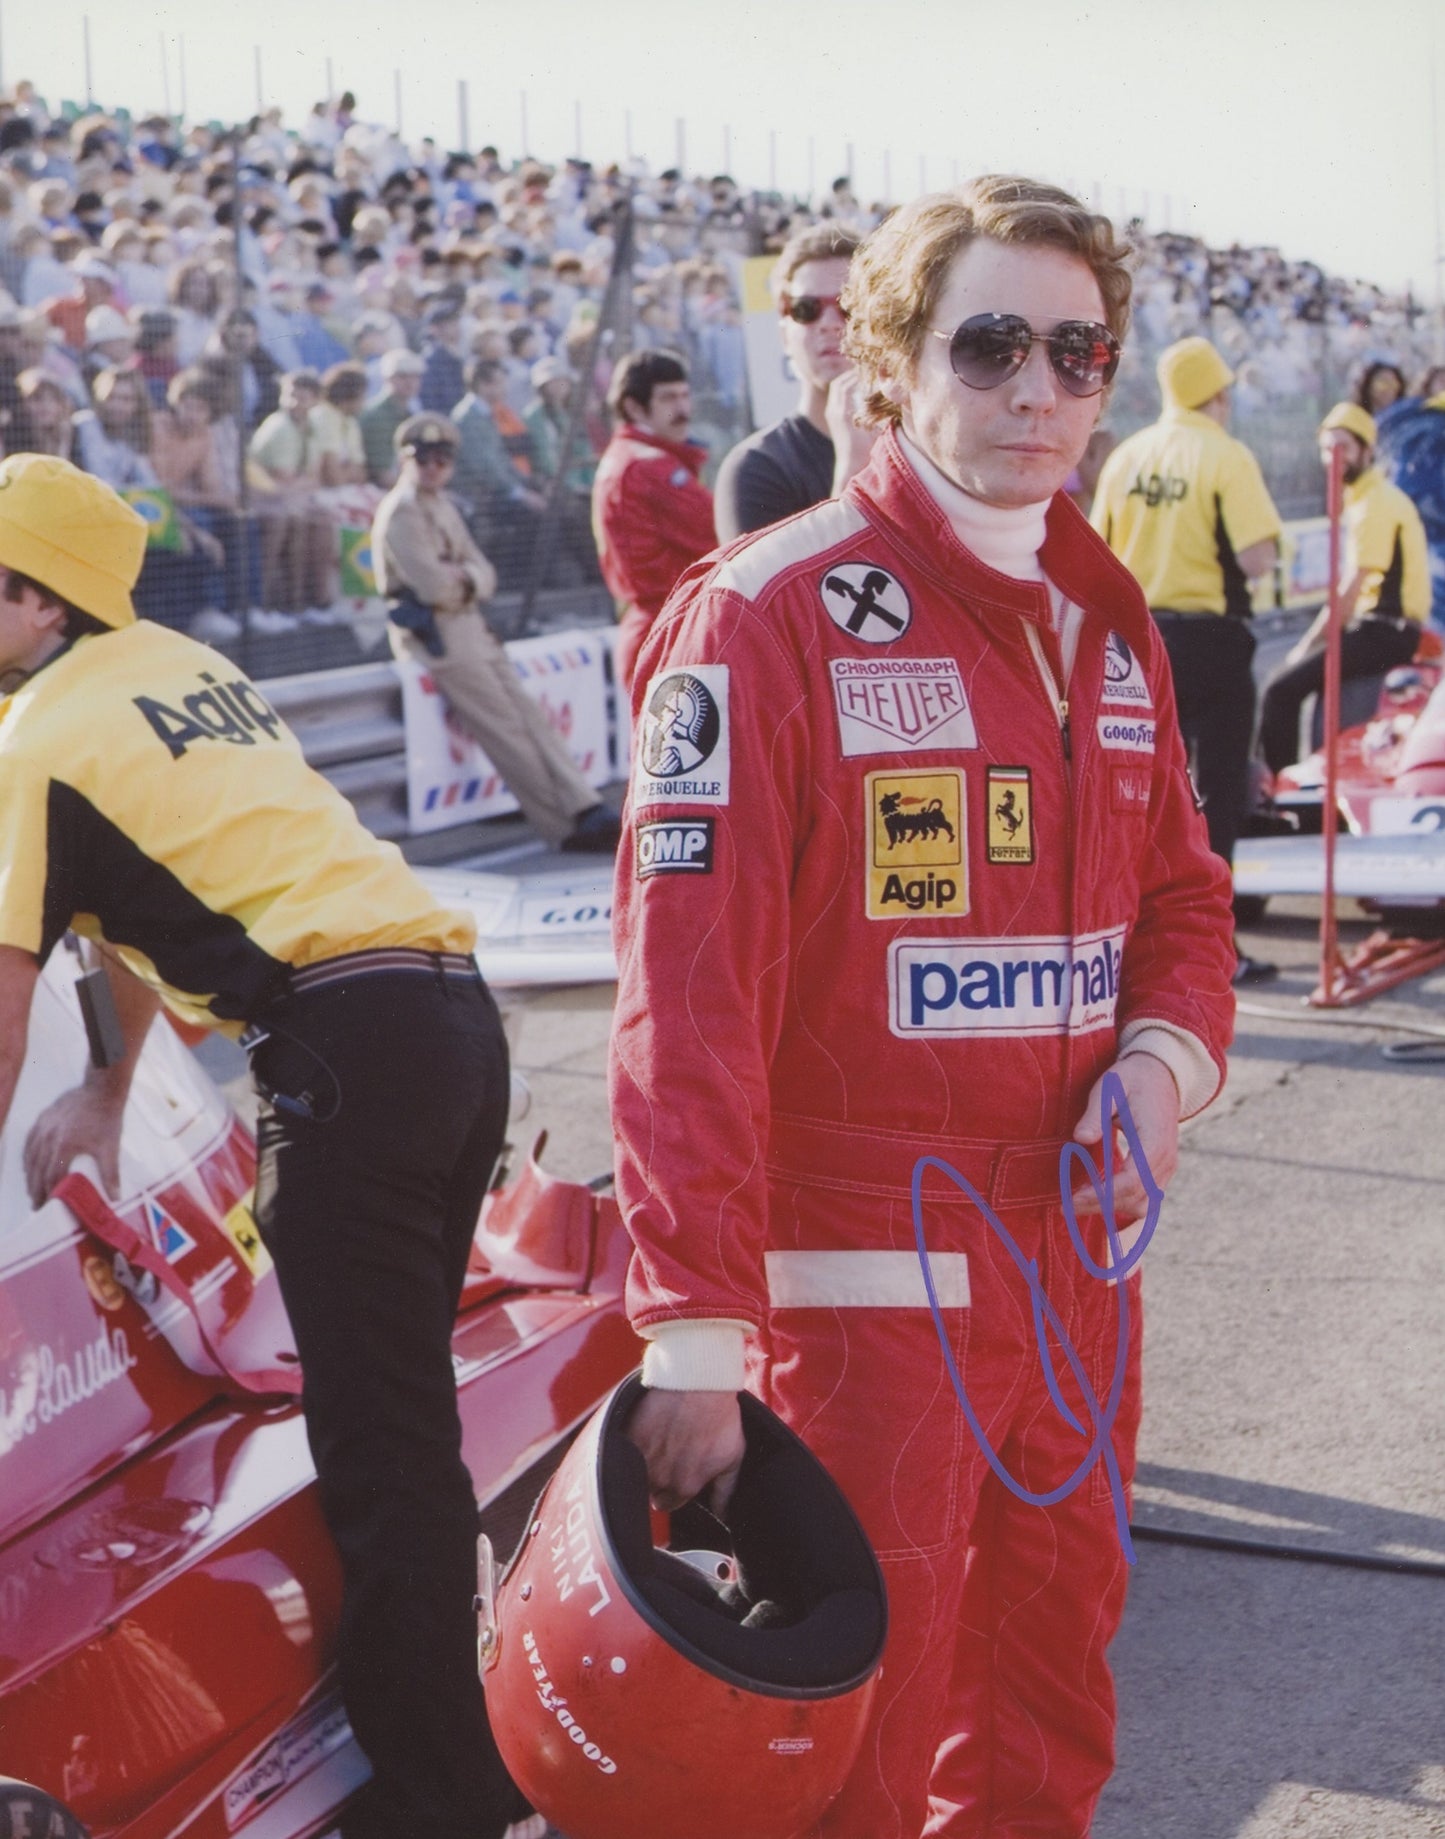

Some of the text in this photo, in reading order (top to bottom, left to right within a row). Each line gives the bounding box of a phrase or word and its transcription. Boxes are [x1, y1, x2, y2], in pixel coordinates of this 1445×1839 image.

[834, 660, 957, 676] CHRONOGRAPH
[131, 671, 280, 760] Agip
[847, 682, 959, 736] HEUER
[641, 780, 721, 796] ERQUELLE
[639, 830, 707, 865] OMP
[990, 846, 1030, 858] Ferrari
[880, 873, 957, 910] Agip
[551, 1524, 574, 1602] NIKI
[565, 1478, 612, 1617] LAUDA
[522, 1630, 618, 1774] GOODYEAR
